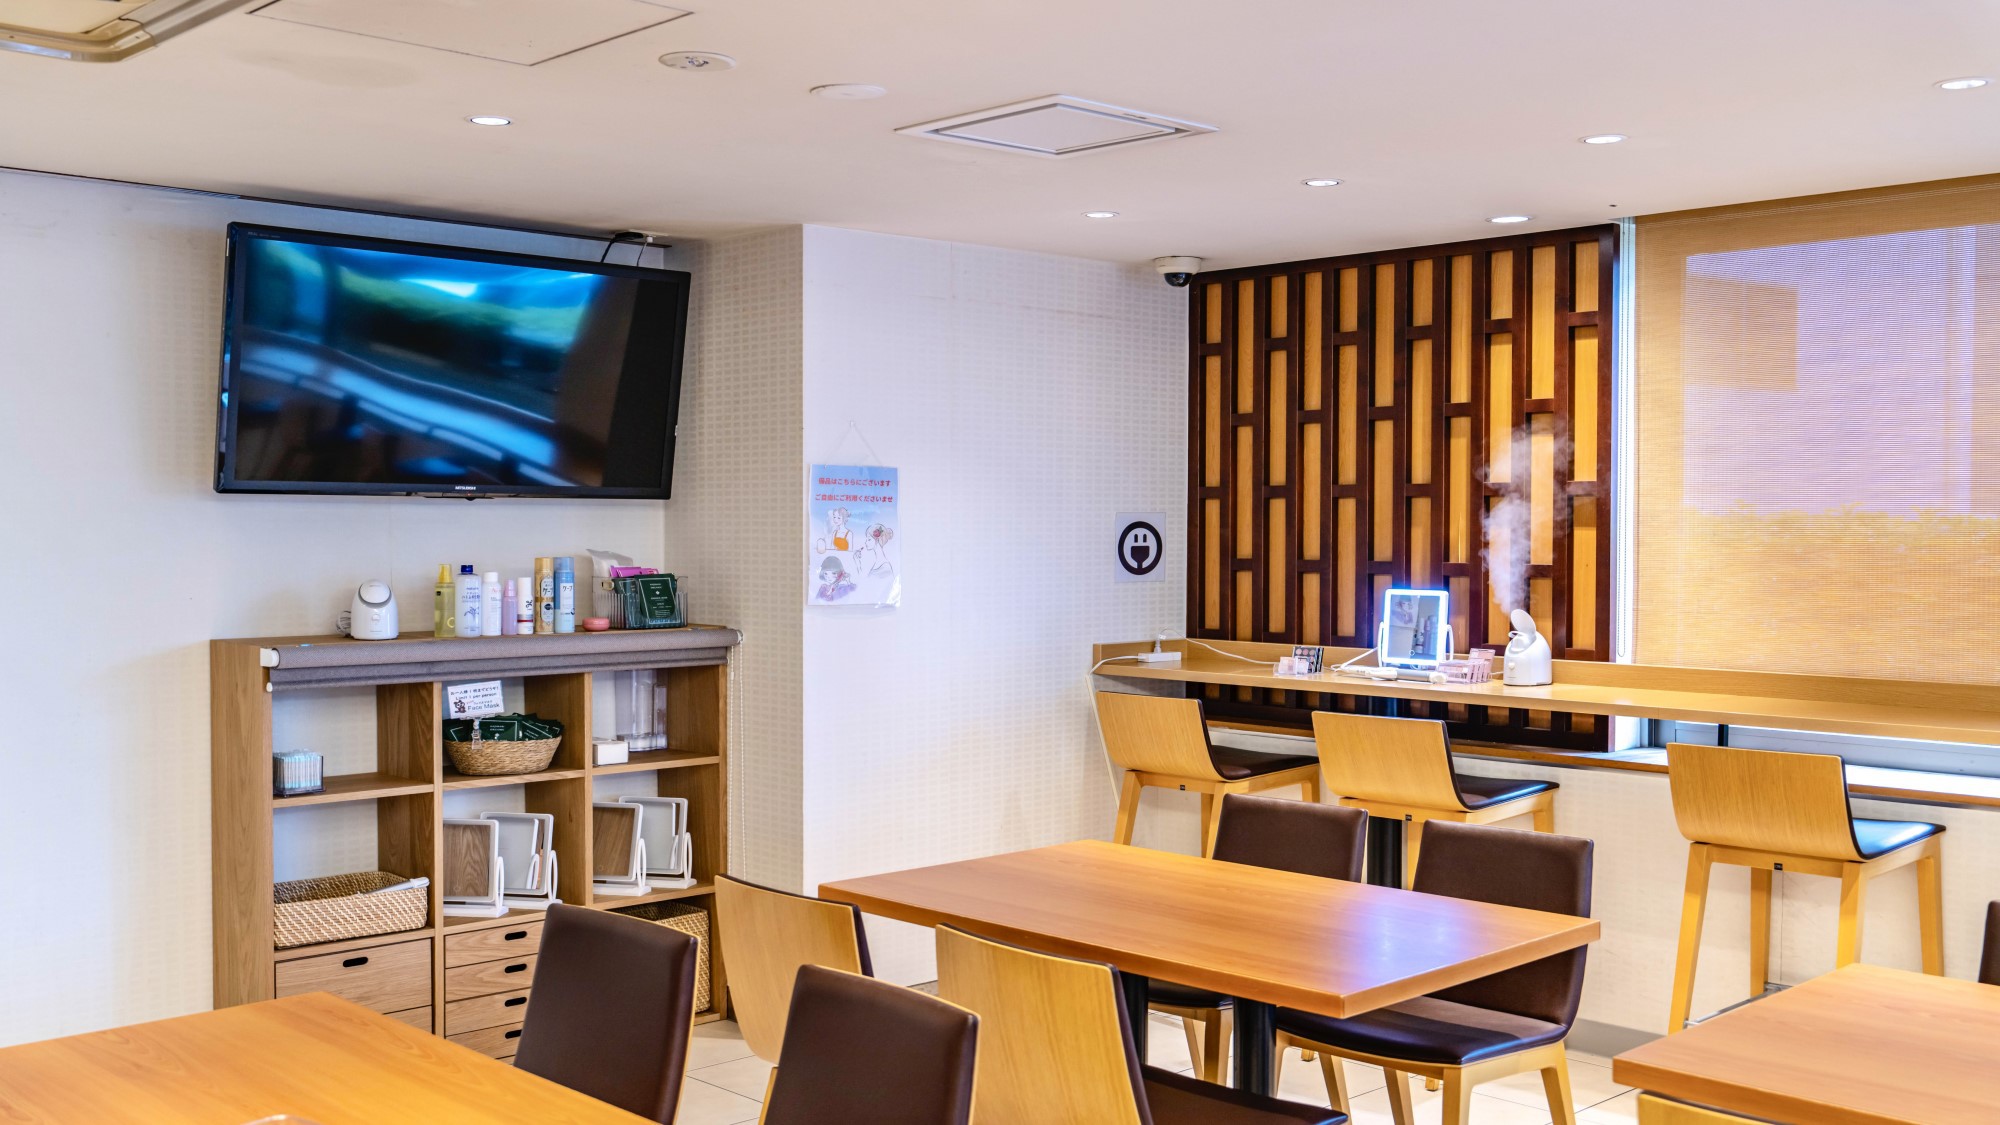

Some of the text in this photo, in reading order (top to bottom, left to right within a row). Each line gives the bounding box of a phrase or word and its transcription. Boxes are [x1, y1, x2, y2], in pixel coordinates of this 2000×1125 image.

[815, 494, 893, 502] ご自由にご利用くださいませ
